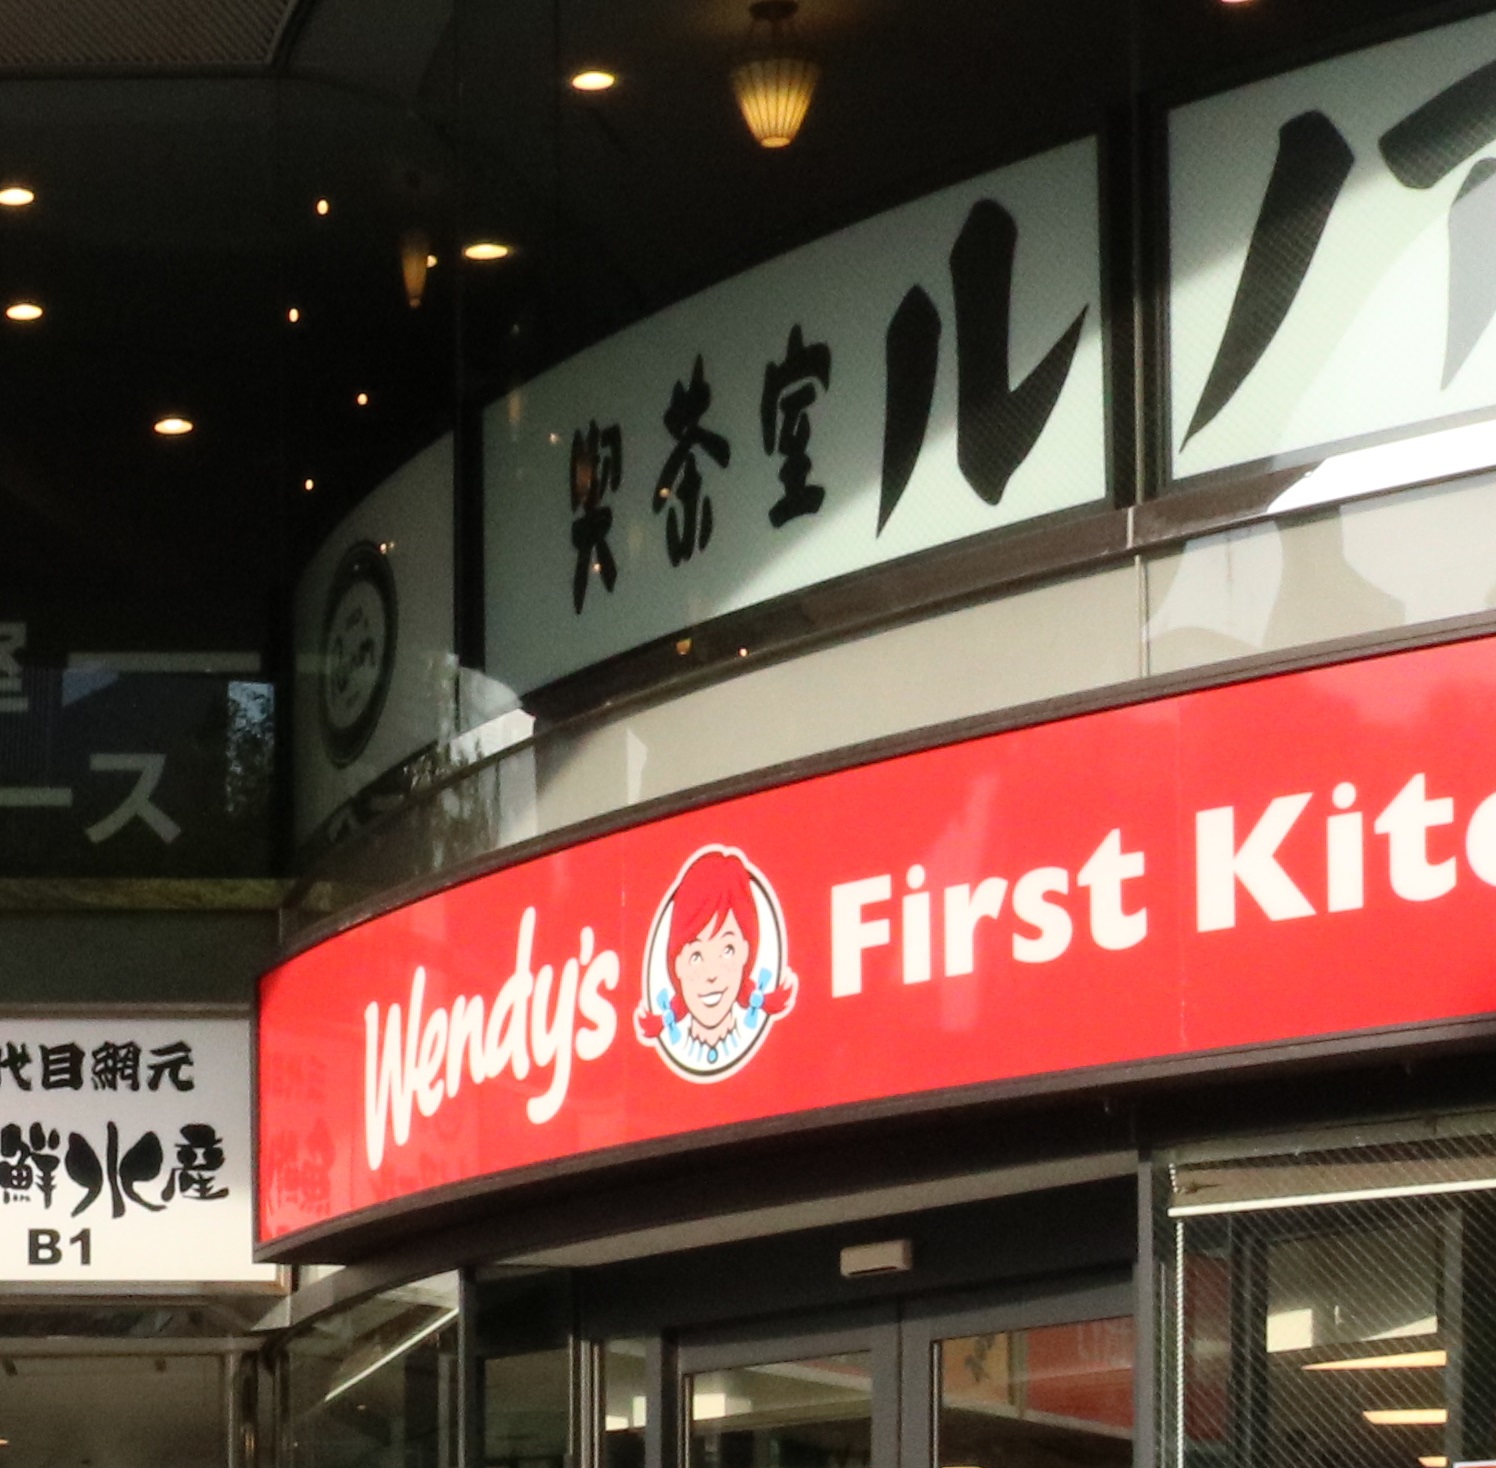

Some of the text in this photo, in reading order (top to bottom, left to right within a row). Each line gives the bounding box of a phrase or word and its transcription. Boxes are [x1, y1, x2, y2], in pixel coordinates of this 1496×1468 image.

[569, 325, 832, 614] 喫茶室
[365, 906, 617, 1171] Wendy's
[830, 828, 1146, 999] First
[27, 1228, 92, 1265] B1
